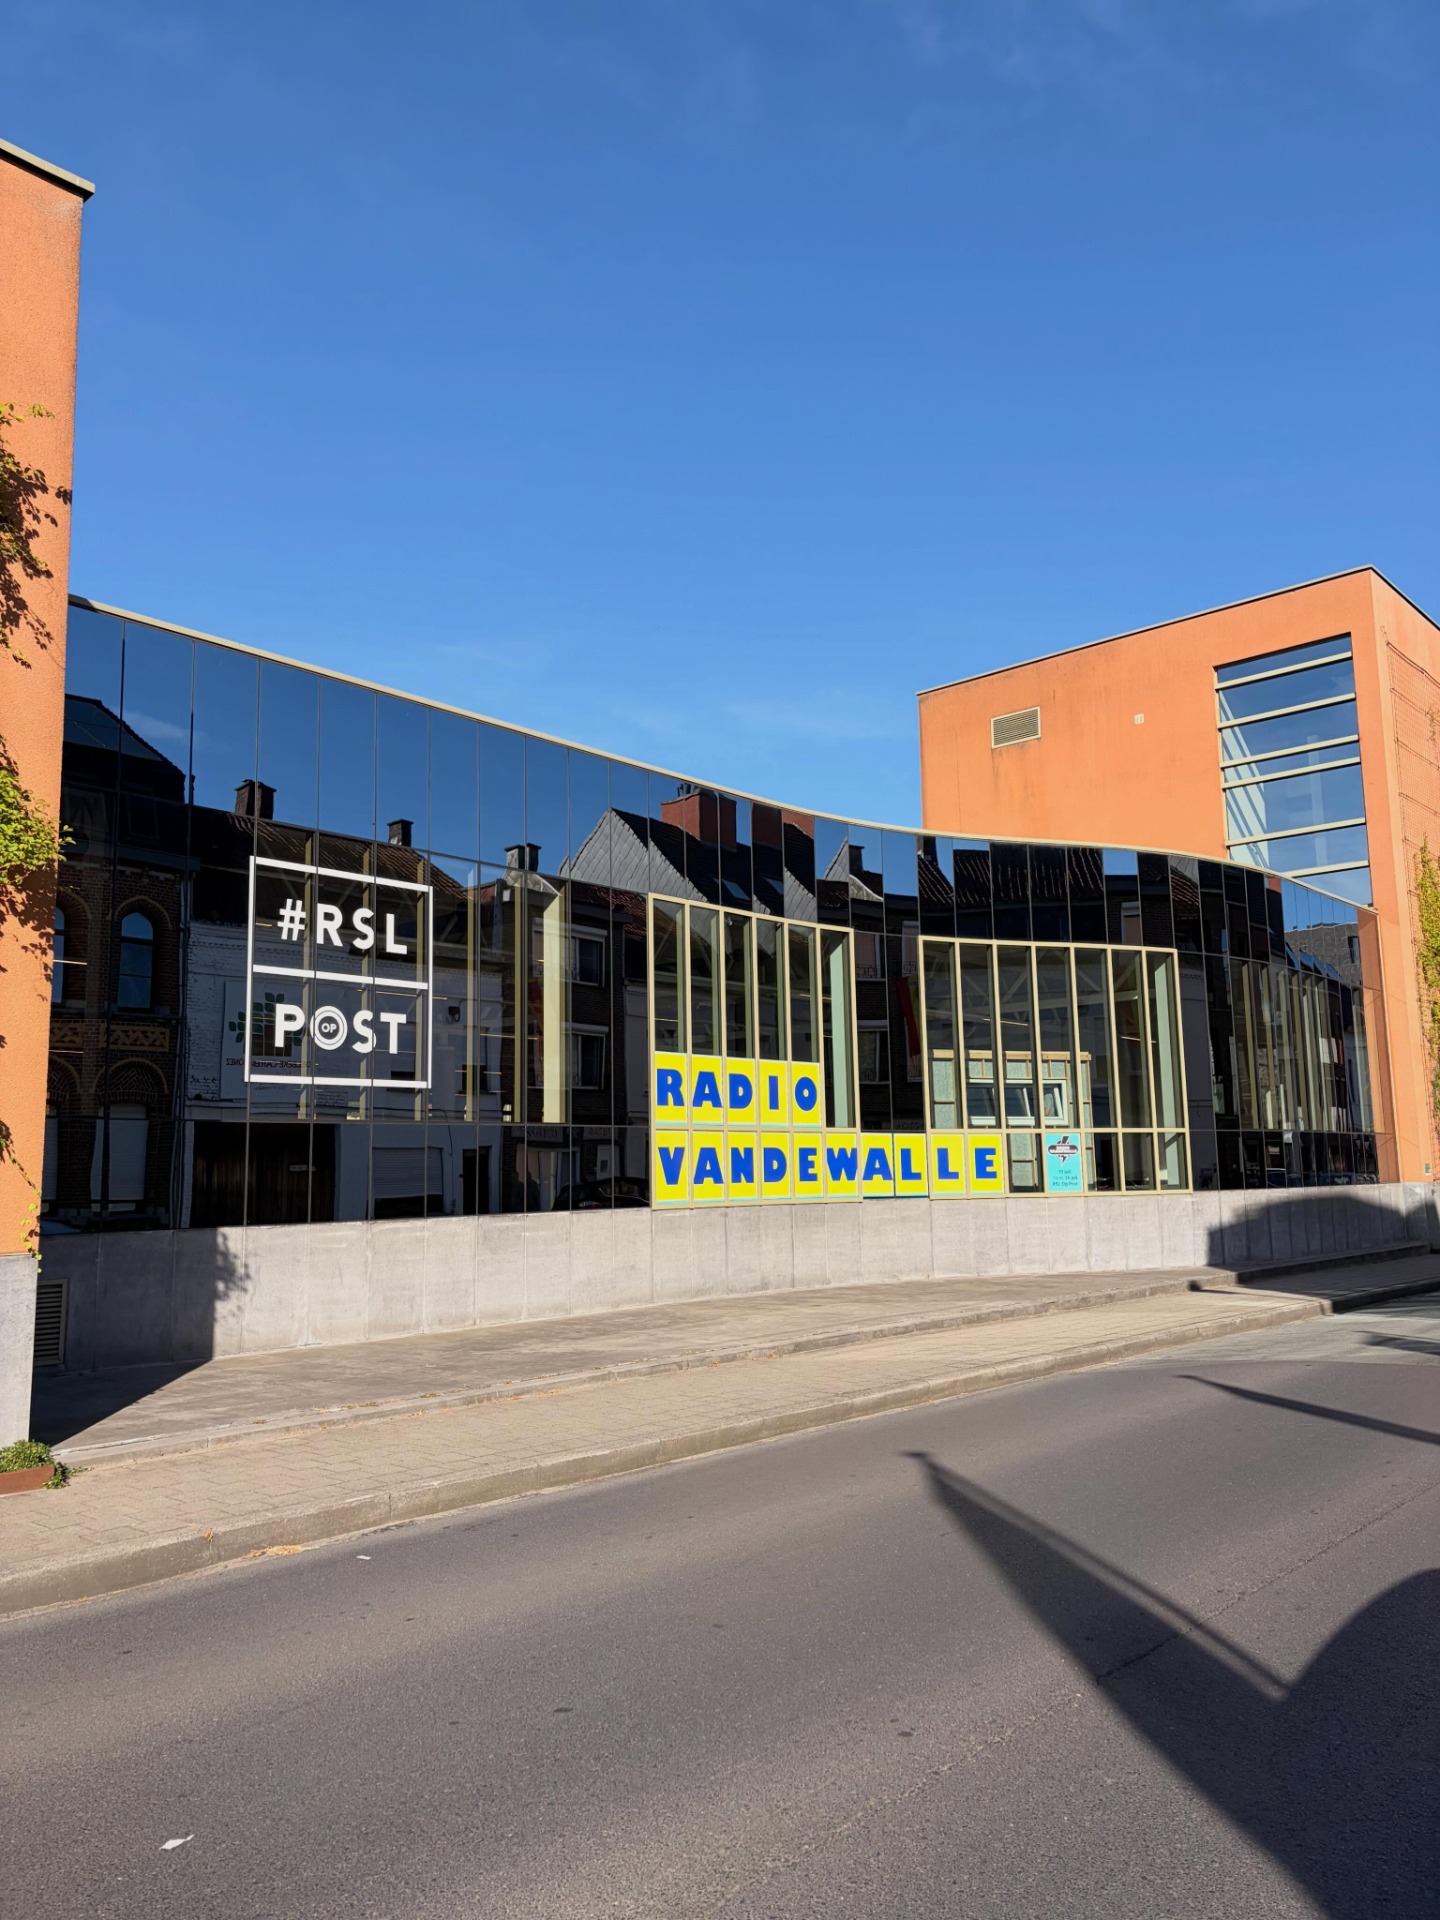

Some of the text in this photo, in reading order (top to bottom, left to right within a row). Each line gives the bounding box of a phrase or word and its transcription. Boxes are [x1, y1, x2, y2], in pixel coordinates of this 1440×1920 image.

[277, 898, 408, 955] #RSL
[274, 1003, 407, 1054] POST
[656, 1068, 818, 1111] RADIO
[658, 1147, 998, 1185] VANDEWALLE
